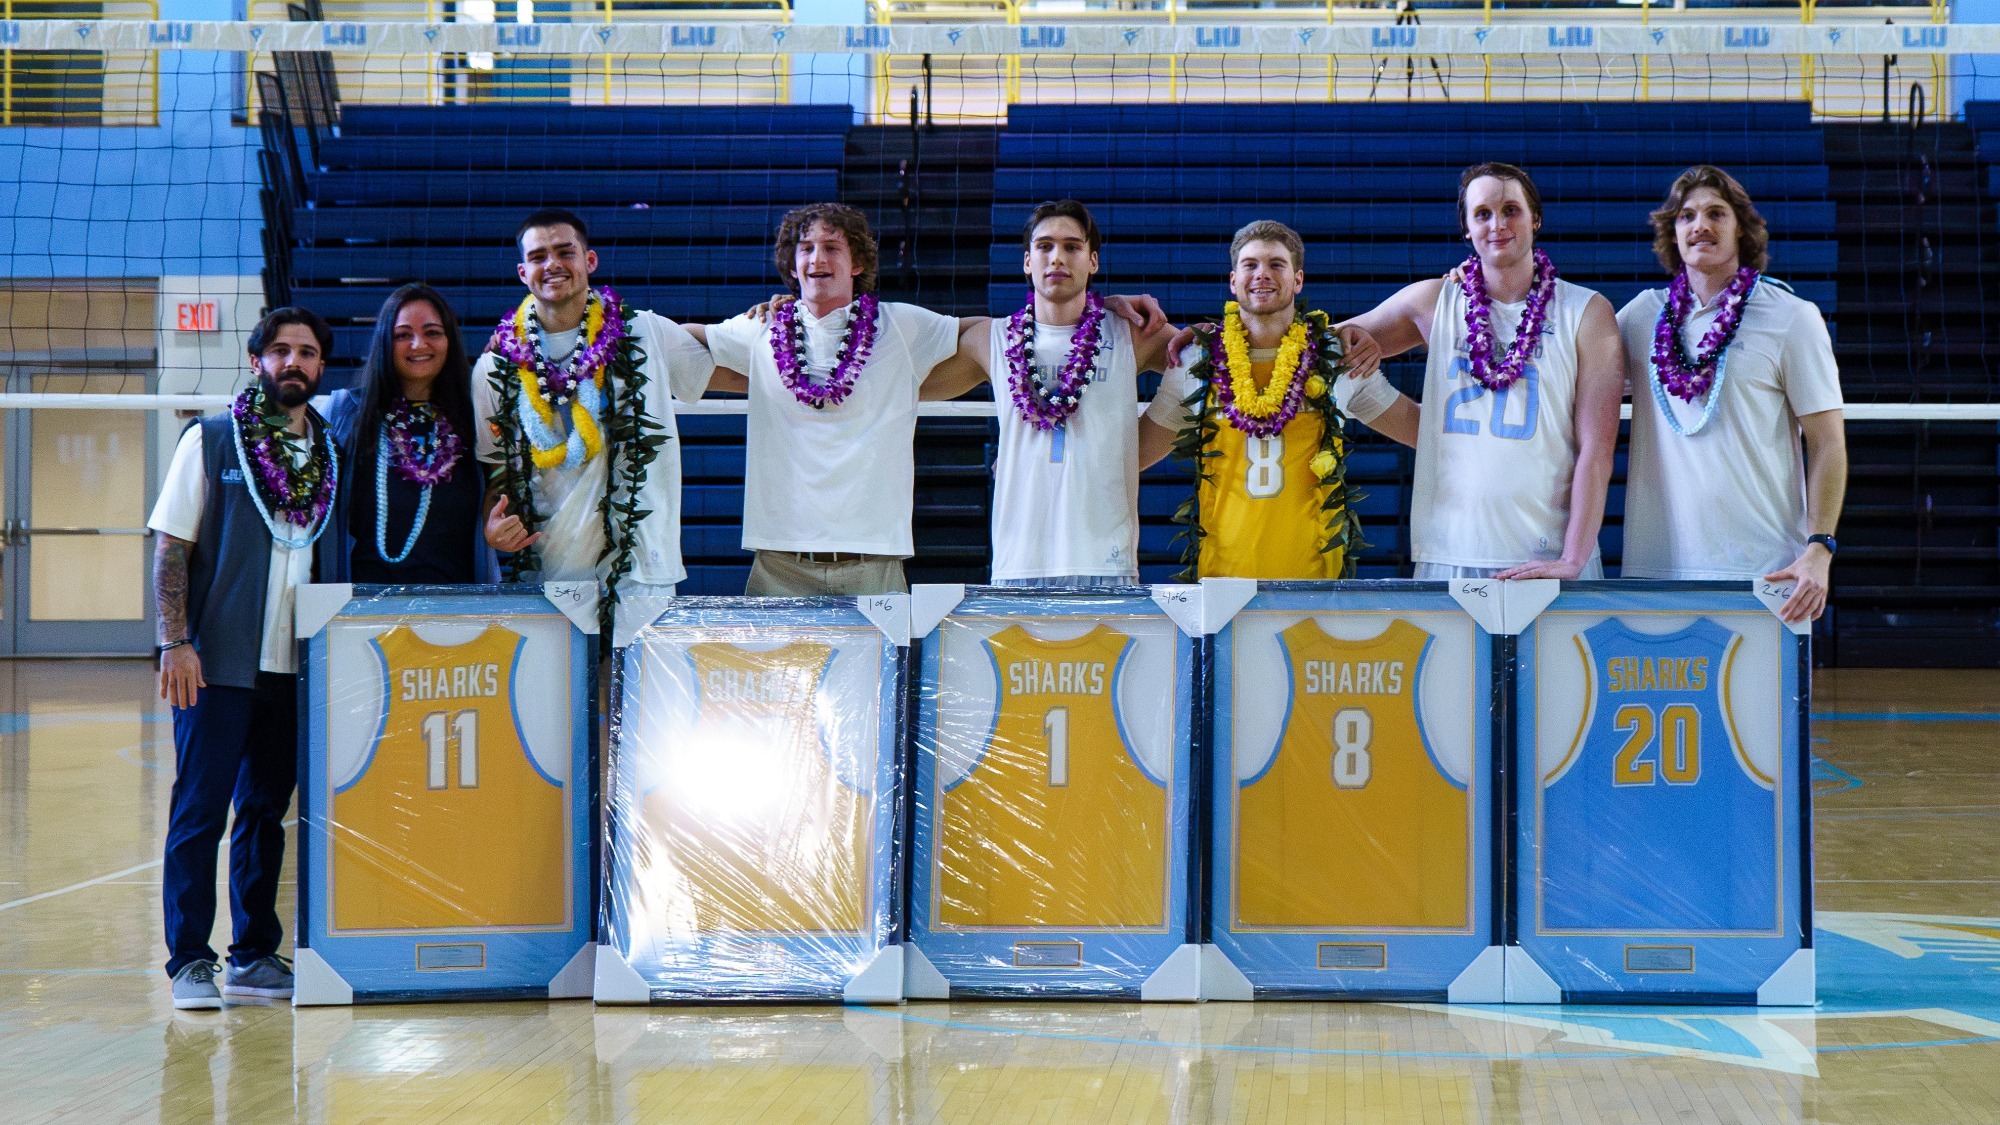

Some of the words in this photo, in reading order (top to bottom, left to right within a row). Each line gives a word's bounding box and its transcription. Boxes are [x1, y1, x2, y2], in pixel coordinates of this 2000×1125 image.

[150, 23, 192, 43] LIU
[324, 24, 367, 44] LIU
[497, 26, 541, 46] LIU
[672, 26, 715, 46] LIU
[846, 26, 889, 47] LIU
[1021, 26, 1065, 47] LIU
[1196, 26, 1240, 47] LIU
[1372, 26, 1416, 47] LIU
[1548, 26, 1593, 47] LIU
[1725, 26, 1769, 47] LIU
[1903, 26, 1947, 47] LIU
[178, 303, 214, 331] EXIT
[1443, 356, 1540, 440] 20
[1246, 431, 1286, 499] 8
[554, 586, 564, 598] 3
[573, 585, 581, 601] 6
[1179, 590, 1187, 602] 6
[1462, 583, 1470, 594] 6
[1478, 584, 1488, 598] 6
[1762, 584, 1776, 596] 2
[1781, 587, 1791, 600] 6
[884, 598, 893, 611] 6
[401, 663, 499, 702] SHARKS
[1009, 661, 1105, 695] SHARKS
[1304, 660, 1404, 694] SHARKS
[1608, 656, 1708, 692] SHARKS
[421, 708, 479, 791] 11
[1042, 706, 1069, 787] 1
[1330, 706, 1374, 790] 8
[1612, 702, 1703, 787] 20
